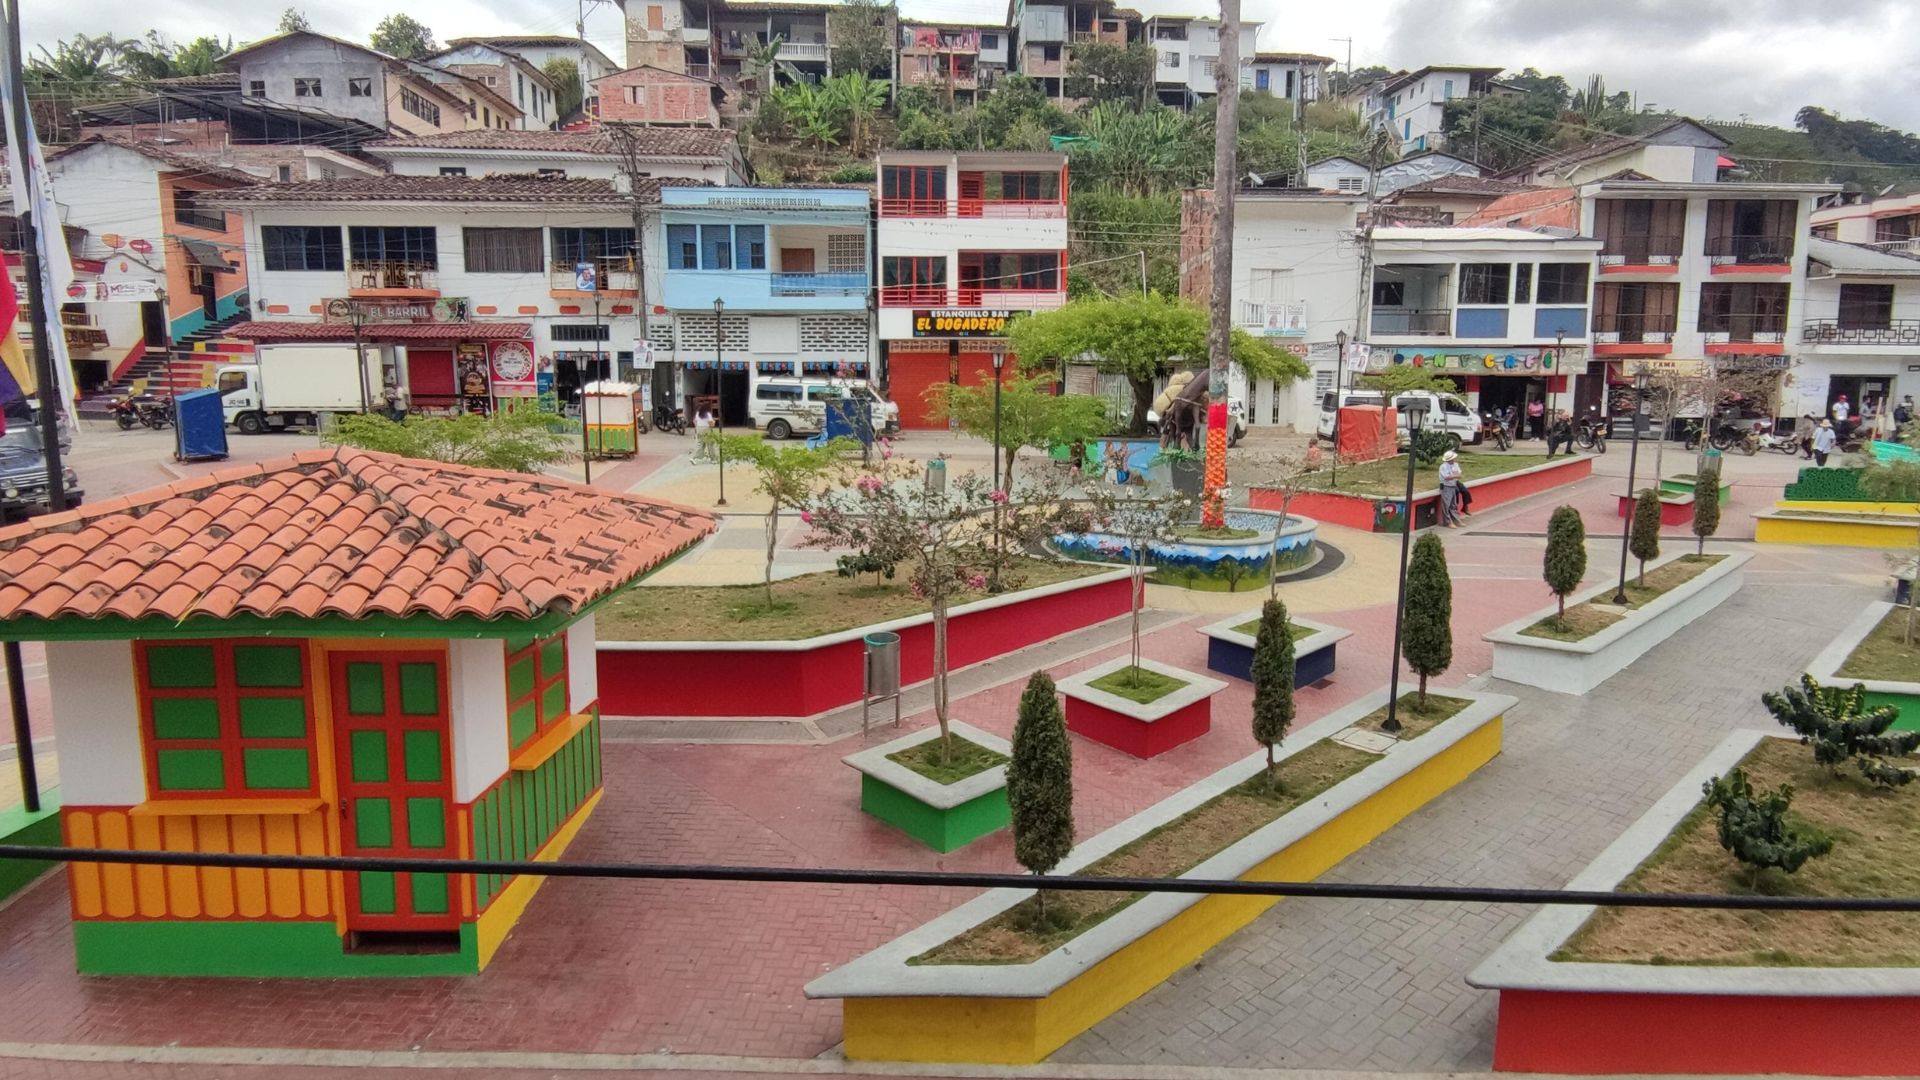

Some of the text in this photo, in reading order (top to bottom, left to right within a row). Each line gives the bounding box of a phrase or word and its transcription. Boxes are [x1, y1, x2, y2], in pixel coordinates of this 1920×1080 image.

[370, 307, 430, 318] EL BARRIL
[931, 310, 989, 318] ESTANQUILLO
[916, 317, 1005, 331] EL BOGADERO
